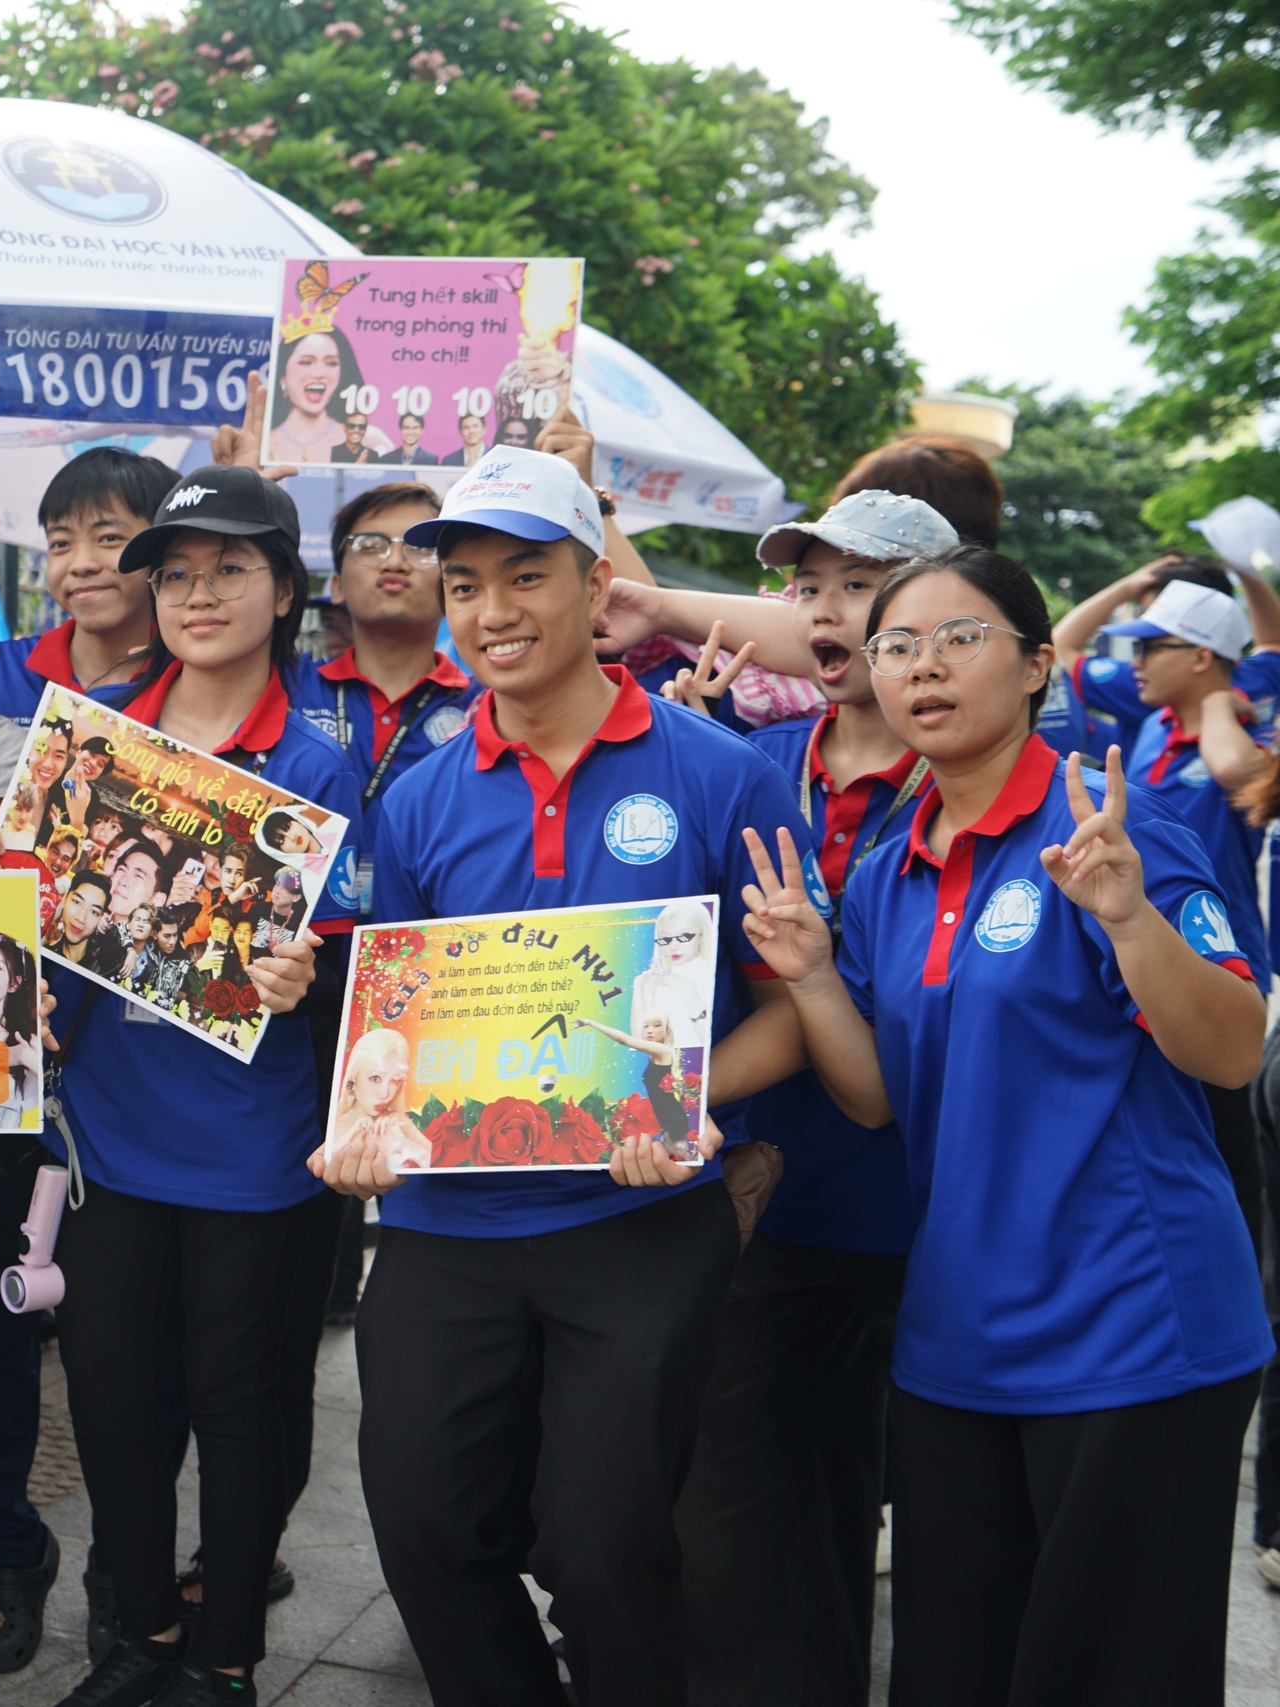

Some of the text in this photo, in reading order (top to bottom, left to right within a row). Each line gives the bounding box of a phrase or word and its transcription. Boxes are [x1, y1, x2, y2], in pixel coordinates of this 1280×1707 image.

[368, 285, 498, 307] Tung hết skill
[355, 315, 508, 338] trong phòng thi
[65, 329, 100, 349] ĐÀI
[105, 332, 132, 350] TƯ
[134, 332, 176, 351] VẤN
[392, 346, 470, 367] cho chị!!
[340, 384, 559, 420] 10 10 10 10
[104, 731, 272, 835] Sóng gió về đây
[129, 787, 223, 845] Có anh lo
[438, 955, 571, 978] ai làm em đau đớn đến thế?
[431, 976, 573, 1000] anh làm em đau đớn đến thế?
[420, 998, 580, 1021] Em làm em đau đớn đến thế này?
[414, 1037, 477, 1083] EM
